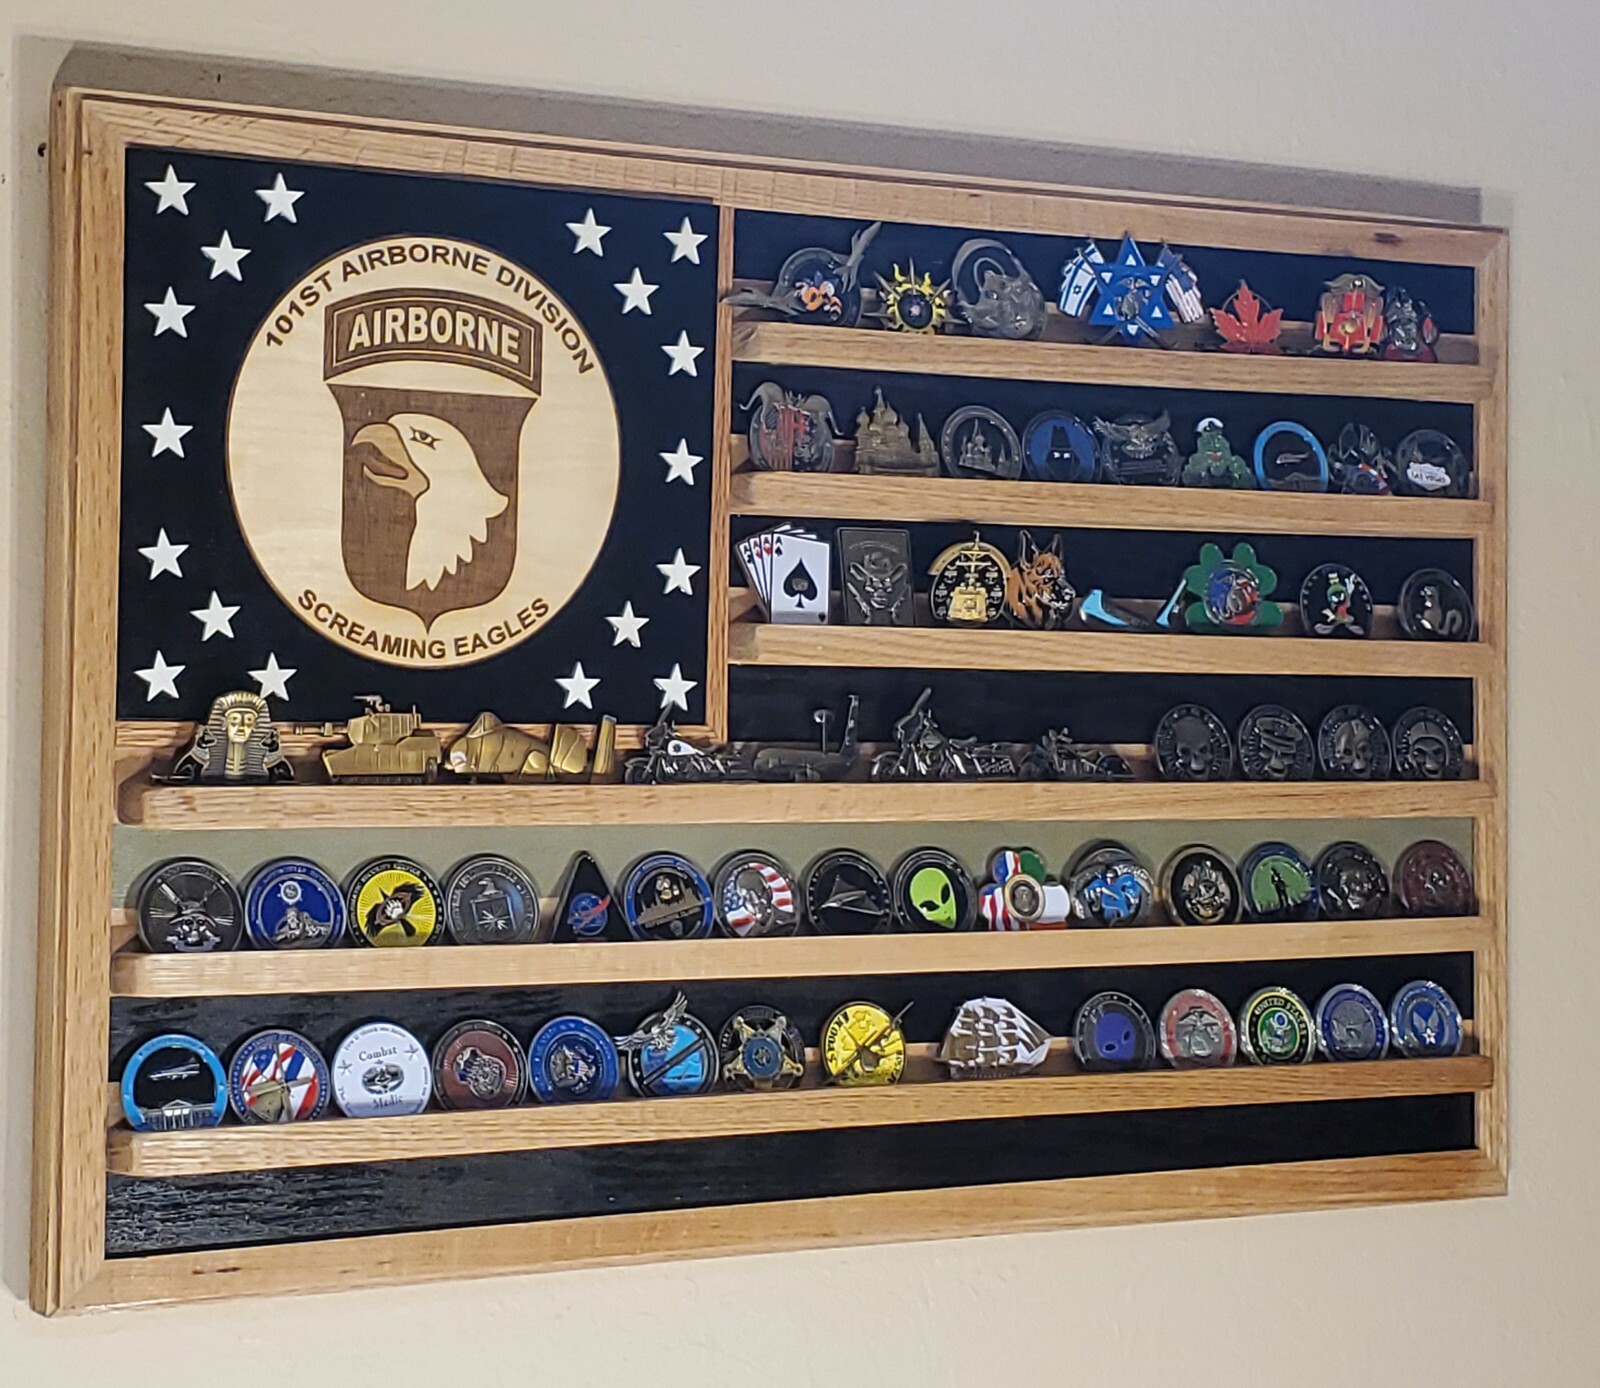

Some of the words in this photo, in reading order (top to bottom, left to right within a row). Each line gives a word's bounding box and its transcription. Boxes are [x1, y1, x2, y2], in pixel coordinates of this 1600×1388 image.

[265, 271, 334, 350] 101ST
[341, 243, 491, 283] AIRBORNE
[495, 264, 594, 376] DIVISION
[347, 306, 522, 365] AIRBORNE
[297, 589, 448, 661] SCREAMING
[454, 596, 550, 657] EAGLES
[358, 1045, 398, 1062] Combat
[372, 1094, 404, 1110] Medic
